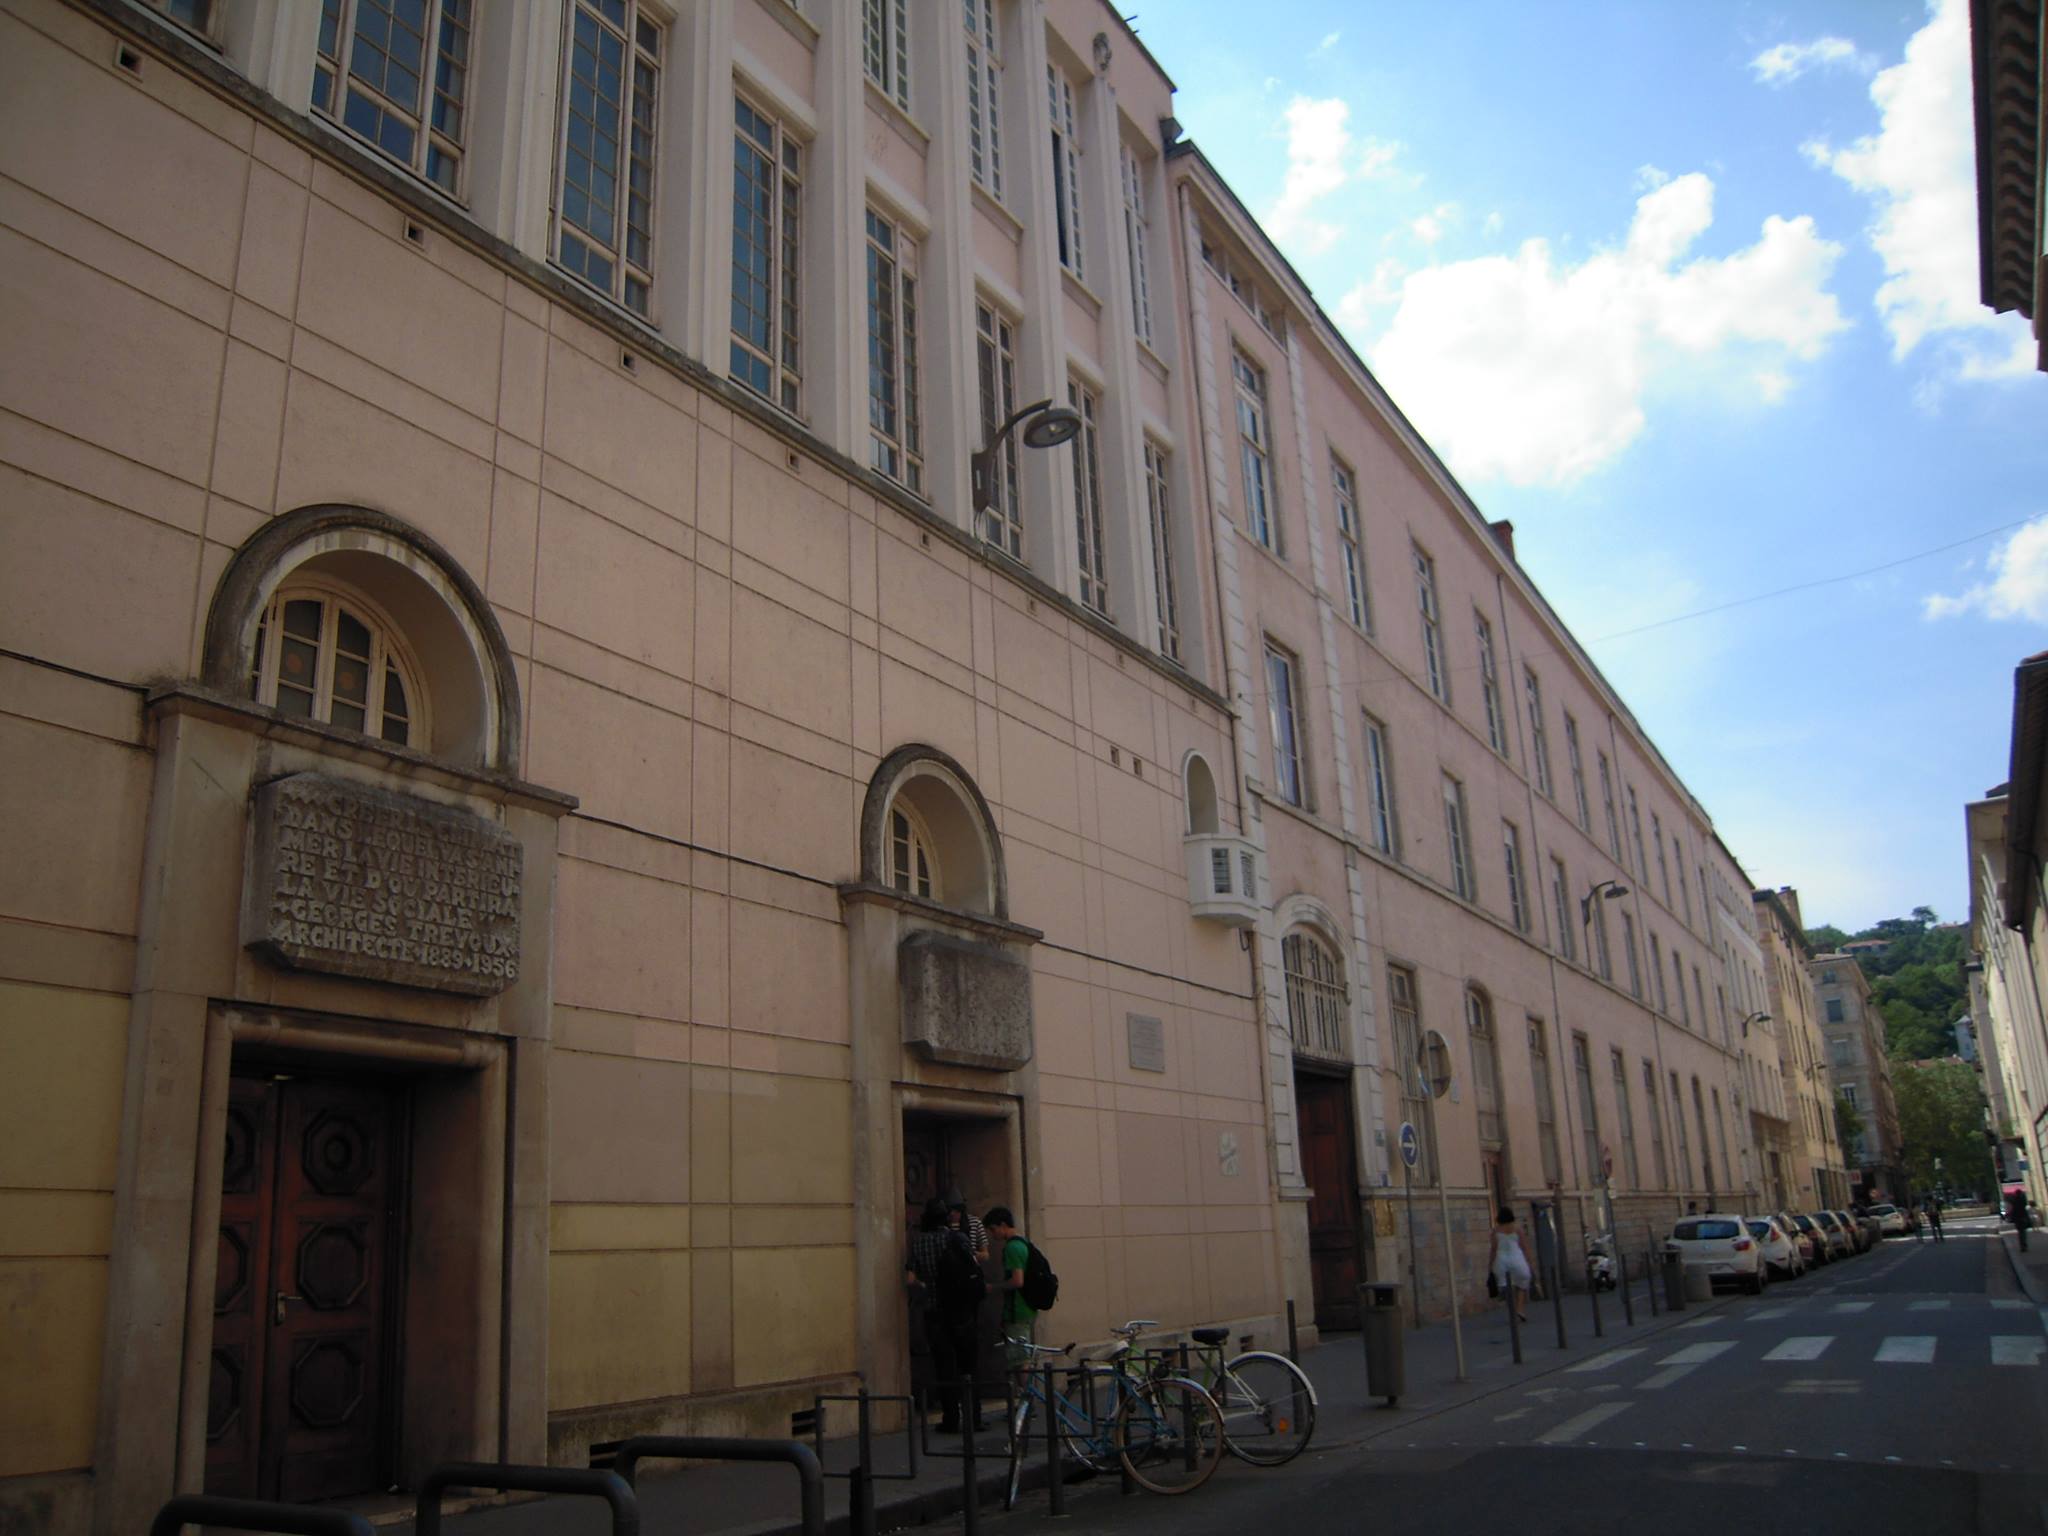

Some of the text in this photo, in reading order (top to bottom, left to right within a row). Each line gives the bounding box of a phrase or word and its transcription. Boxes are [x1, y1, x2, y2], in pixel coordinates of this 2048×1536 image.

[283, 801, 353, 840] DANS
[280, 825, 339, 859] MER
[376, 848, 416, 876] VIE
[277, 871, 315, 899] LA
[321, 880, 366, 909] VIE
[280, 848, 315, 876] RE
[323, 858, 360, 885] ET
[423, 879, 515, 917] PARTIRA
[272, 917, 516, 978] ARCHITECTE 1889 1956
[290, 897, 510, 956] GEORGES TREVOUX
